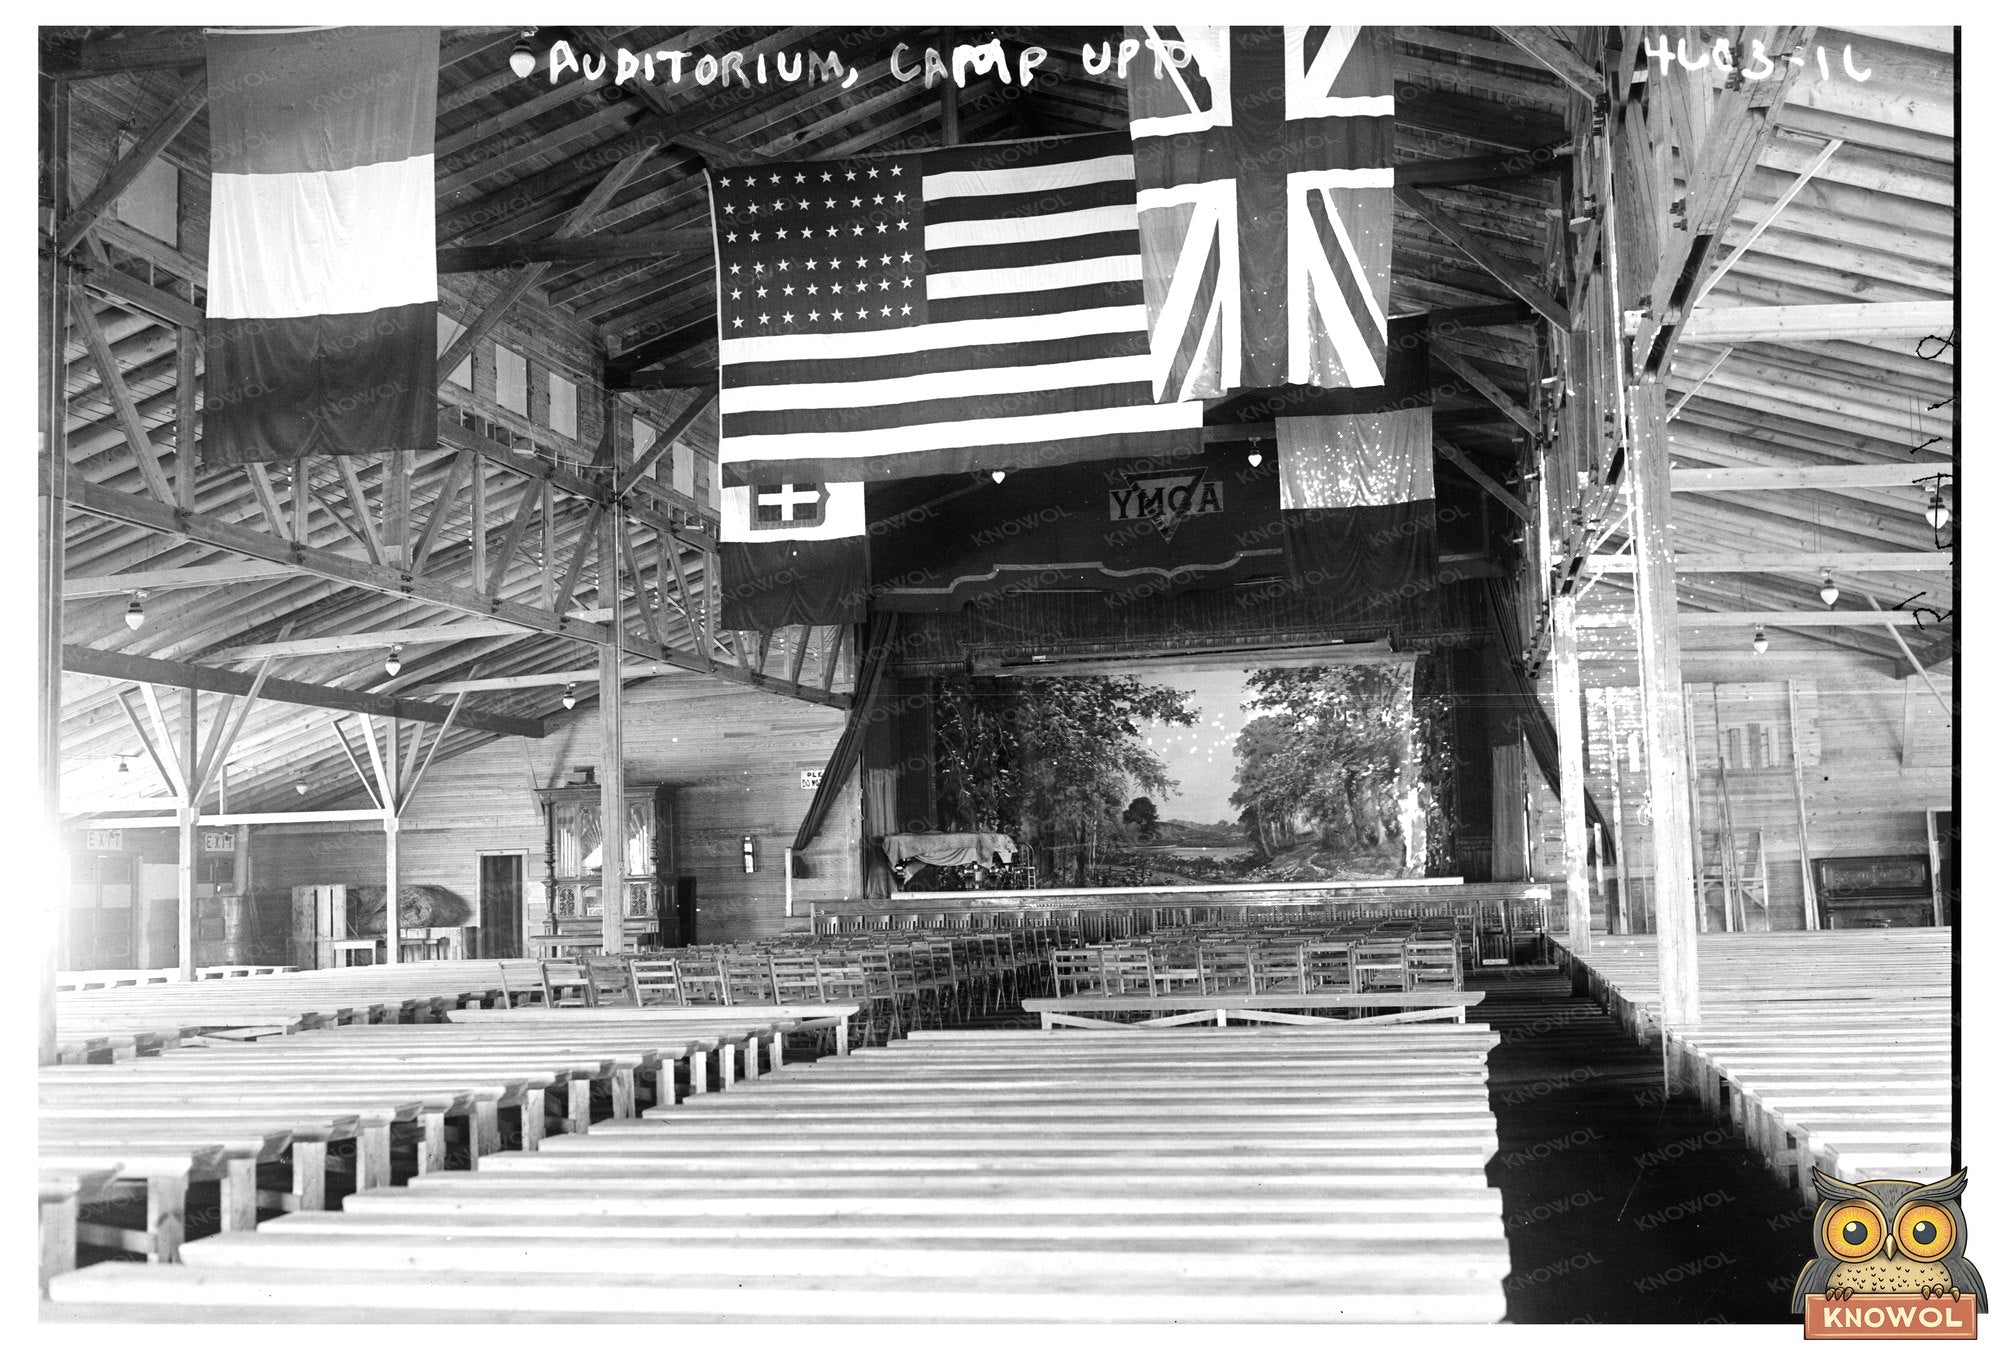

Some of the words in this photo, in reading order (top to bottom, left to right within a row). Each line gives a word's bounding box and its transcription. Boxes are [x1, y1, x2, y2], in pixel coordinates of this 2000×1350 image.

[1110, 483, 1222, 519] YMCA
[89, 832, 121, 847] EXIT
[206, 835, 233, 849] EXIT
